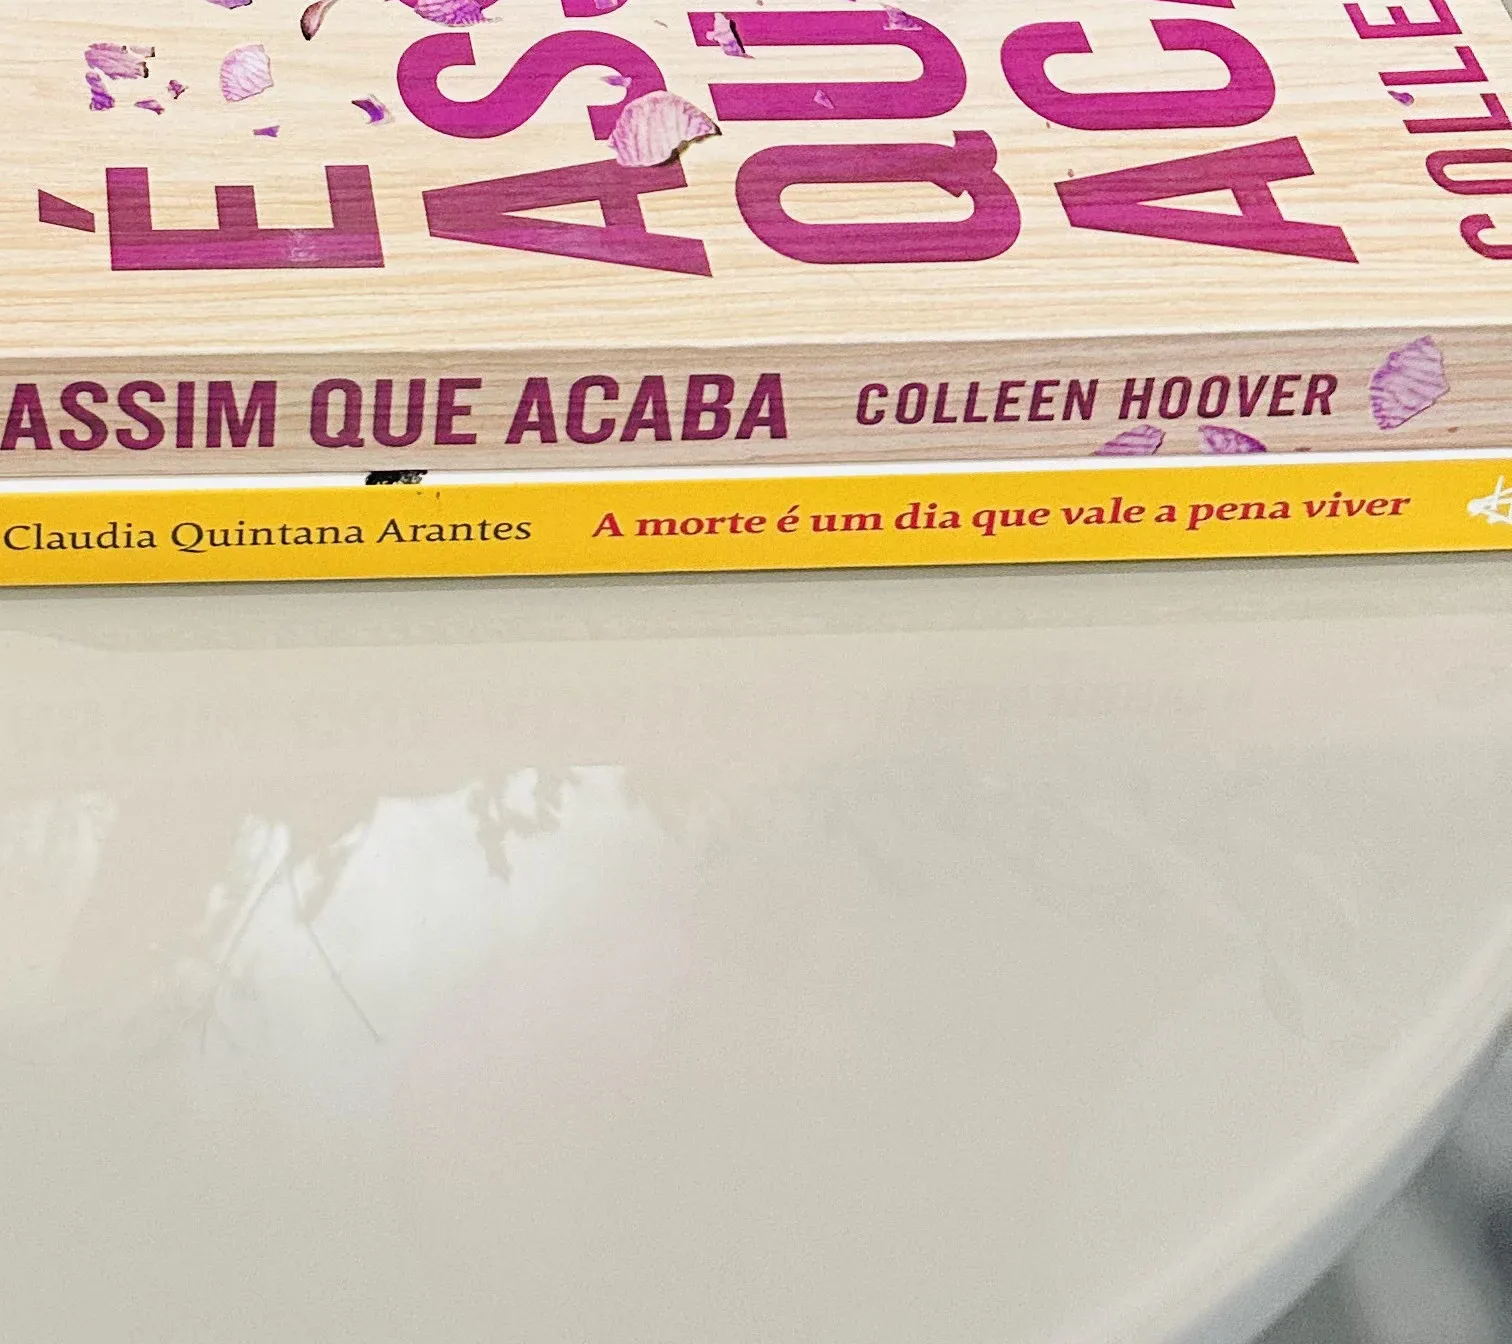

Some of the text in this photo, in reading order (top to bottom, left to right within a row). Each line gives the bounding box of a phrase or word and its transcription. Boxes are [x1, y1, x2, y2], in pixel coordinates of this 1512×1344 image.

[38, 164, 385, 272] É
[308, 376, 483, 450] QUE
[503, 372, 789, 447] ACABA
[855, 378, 1100, 427] COLLEEN
[1117, 373, 1339, 422] HOOVER
[3, 522, 159, 551] Claudia
[170, 520, 366, 554] Quintana
[375, 518, 533, 544] Arantes
[591, 511, 625, 538] A
[634, 511, 768, 537] morte
[776, 504, 801, 534] é
[809, 512, 885, 533] um
[894, 501, 963, 531] dia
[971, 508, 1052, 538] que
[1059, 496, 1147, 526] vale
[1153, 504, 1178, 524] a
[1185, 499, 1293, 532] pena
[1301, 490, 1412, 519] viver
